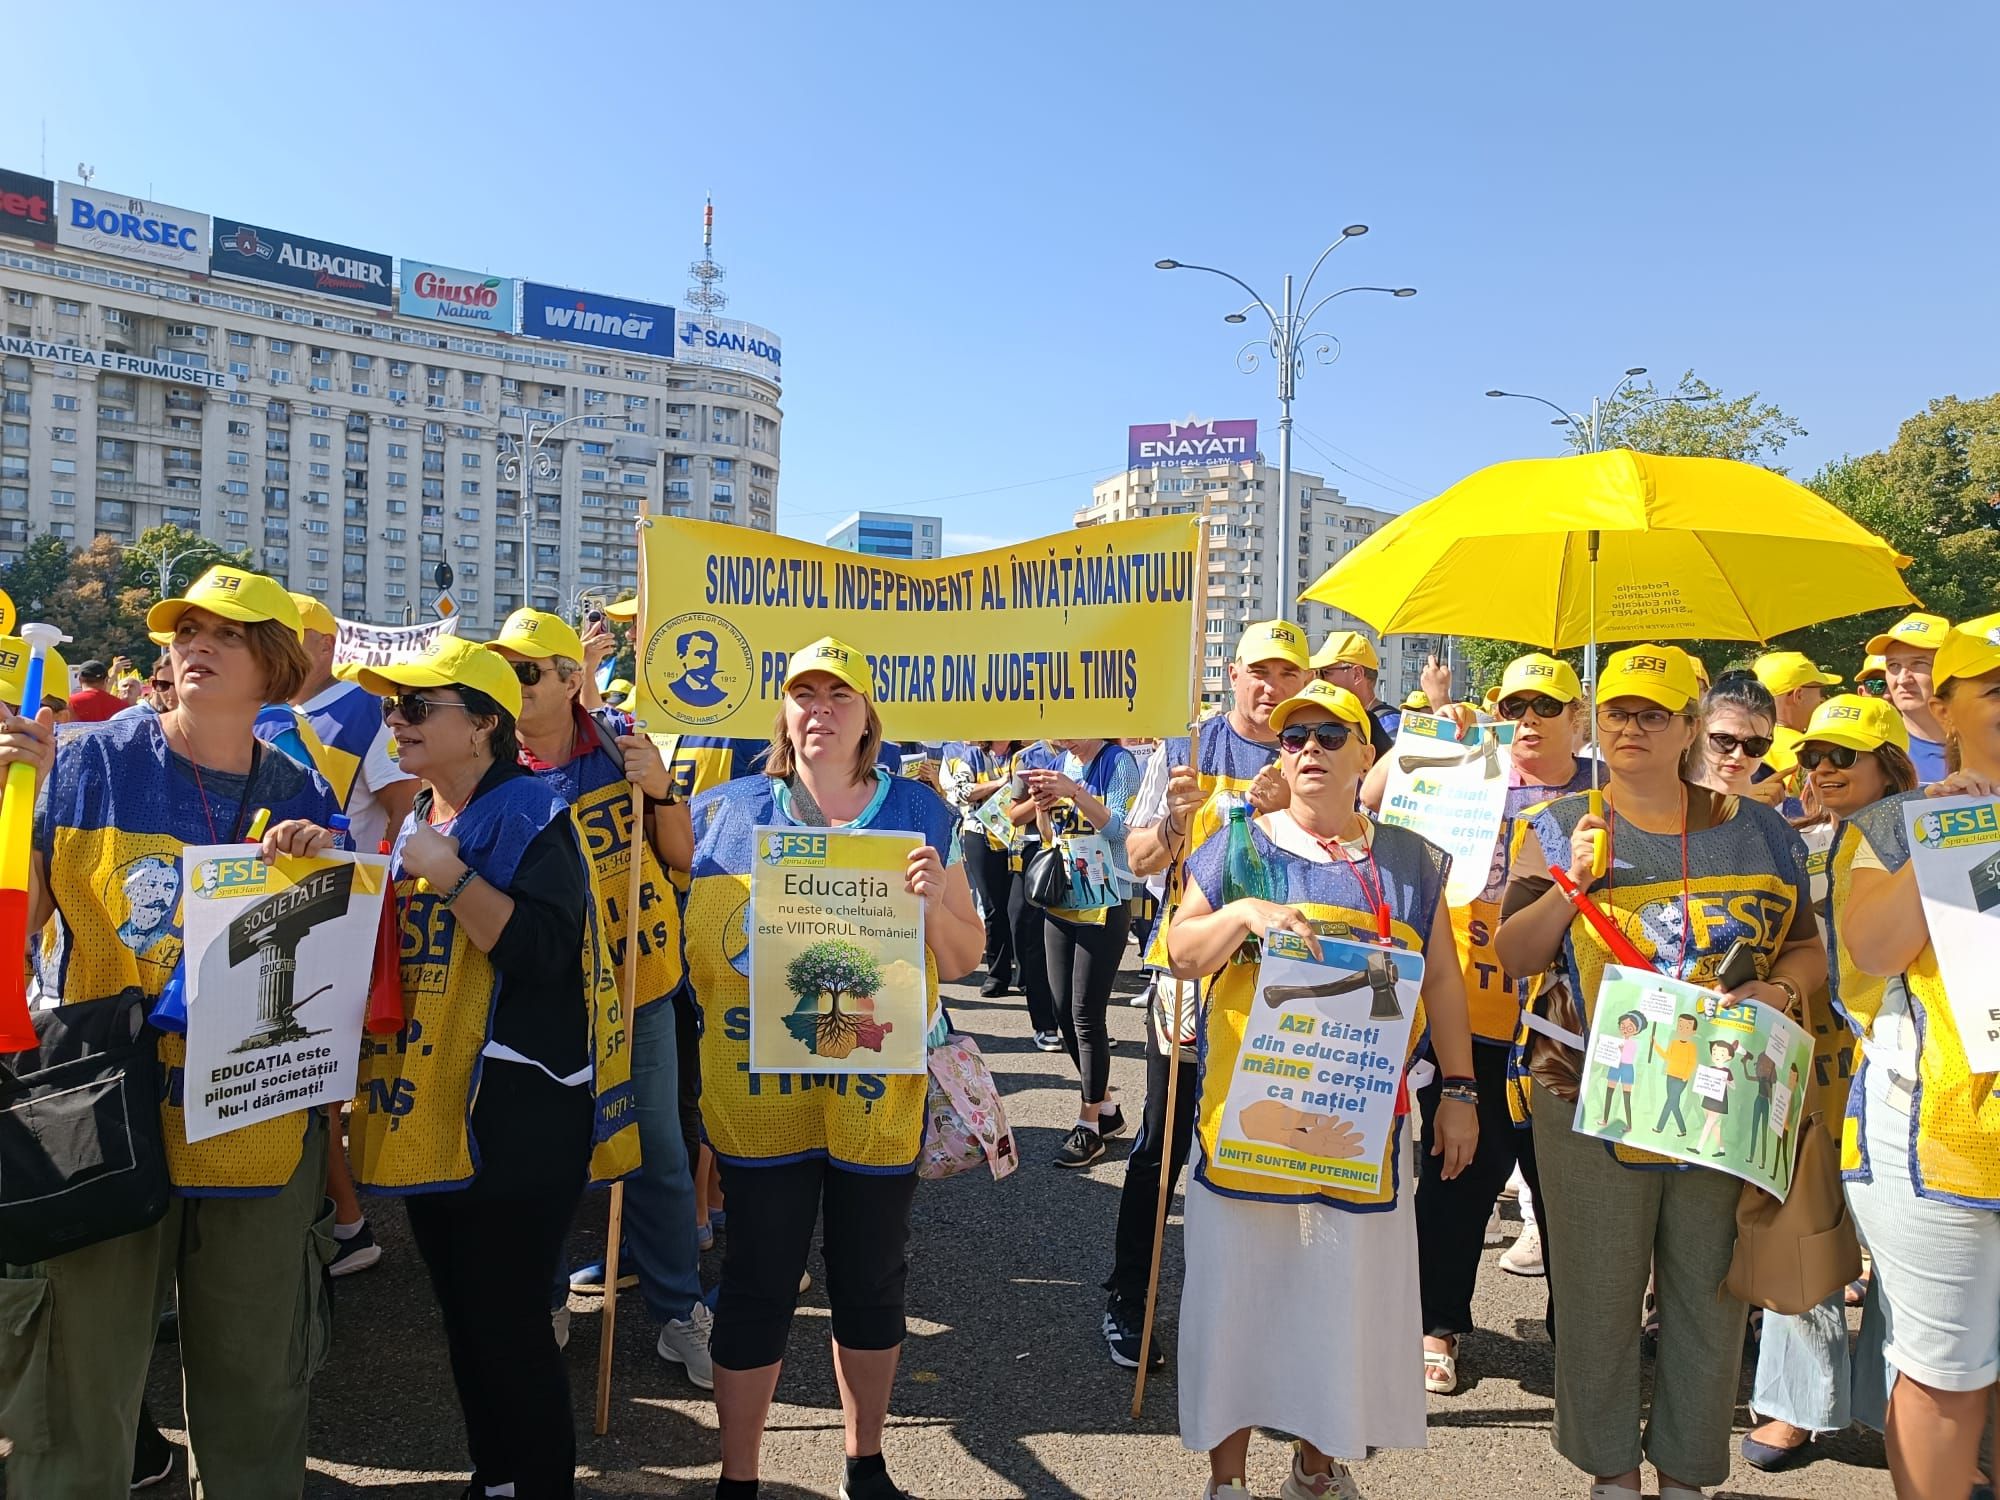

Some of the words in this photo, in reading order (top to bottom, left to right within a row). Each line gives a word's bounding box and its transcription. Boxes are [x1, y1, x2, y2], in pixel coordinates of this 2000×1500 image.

[0, 192, 48, 221] et
[71, 198, 197, 251] BORSEC
[277, 243, 385, 287] ALBACHER
[414, 272, 497, 308] Giusto
[436, 301, 493, 321] Natura
[544, 303, 653, 340] winner
[101, 354, 112, 368] E
[704, 329, 781, 367] SANADOR
[1140, 437, 1245, 458] ENAYATI
[1152, 459, 1200, 468] MEDICAL
[211, 576, 240, 590] SE
[705, 554, 829, 609] SINDICATUL
[835, 562, 974, 611] INDEPENDENT
[981, 565, 1006, 610] AL
[1011, 543, 1193, 625] ÎNVĂȚĂMÂNTULUI
[516, 619, 539, 632] SE
[1272, 628, 1295, 643] FSE
[1903, 621, 1929, 633] FSE
[646, 629, 668, 665] FEDERATIA
[665, 614, 717, 630] SINDICATELOR
[717, 619, 729, 630] DIN
[817, 647, 848, 662] FSE
[1632, 656, 1666, 672] FSE
[663, 671, 679, 679] 1851
[761, 651, 936, 703] PRRSITAR
[942, 654, 976, 702] DIN
[982, 651, 1075, 720] JUDEȚUL
[1081, 648, 1137, 712] TIMIȘ
[1526, 665, 1553, 677] FSE
[675, 711, 696, 723] SPIRU
[696, 713, 719, 723] HARET
[1416, 716, 1439, 730] FSE
[1828, 706, 1861, 720] FSE
[1390, 795, 1418, 811] din
[577, 797, 637, 856] SE
[1939, 807, 1996, 833] FSE
[783, 835, 826, 855] FSE
[218, 859, 266, 883] FSE
[784, 873, 889, 903] Educația
[243, 872, 337, 936] SOCIETATE
[778, 904, 794, 915] nu
[797, 904, 821, 916] este
[825, 907, 833, 916] o
[836, 902, 897, 920] cheltuială,
[400, 895, 448, 958] SE
[758, 924, 784, 935] este
[786, 920, 857, 937] VIITORUL
[859, 925, 918, 940] României!
[1687, 895, 1787, 950] FSE
[259, 959, 296, 976] EDUCATIE
[1279, 1013, 1315, 1035] Azi
[1321, 1020, 1380, 1049] tăiați
[210, 1052, 292, 1083] EDUCAȚIA
[296, 1046, 331, 1062] este
[1251, 1034, 1285, 1053] din
[1292, 1043, 1395, 1075] educație,
[204, 1080, 258, 1107] pilonul
[260, 1060, 338, 1091] societății!
[1241, 1054, 1311, 1080] mâine
[1317, 1067, 1394, 1096] cerșim
[217, 1097, 248, 1120] Nu-l
[252, 1080, 324, 1112] dărâmați!
[1266, 1085, 1295, 1101] ca
[1301, 1086, 1367, 1114] nație!
[1218, 1147, 1253, 1163] UNIȚI
[1255, 1153, 1307, 1171] SUNTEM
[1309, 1163, 1379, 1184] PUTERNICI!
